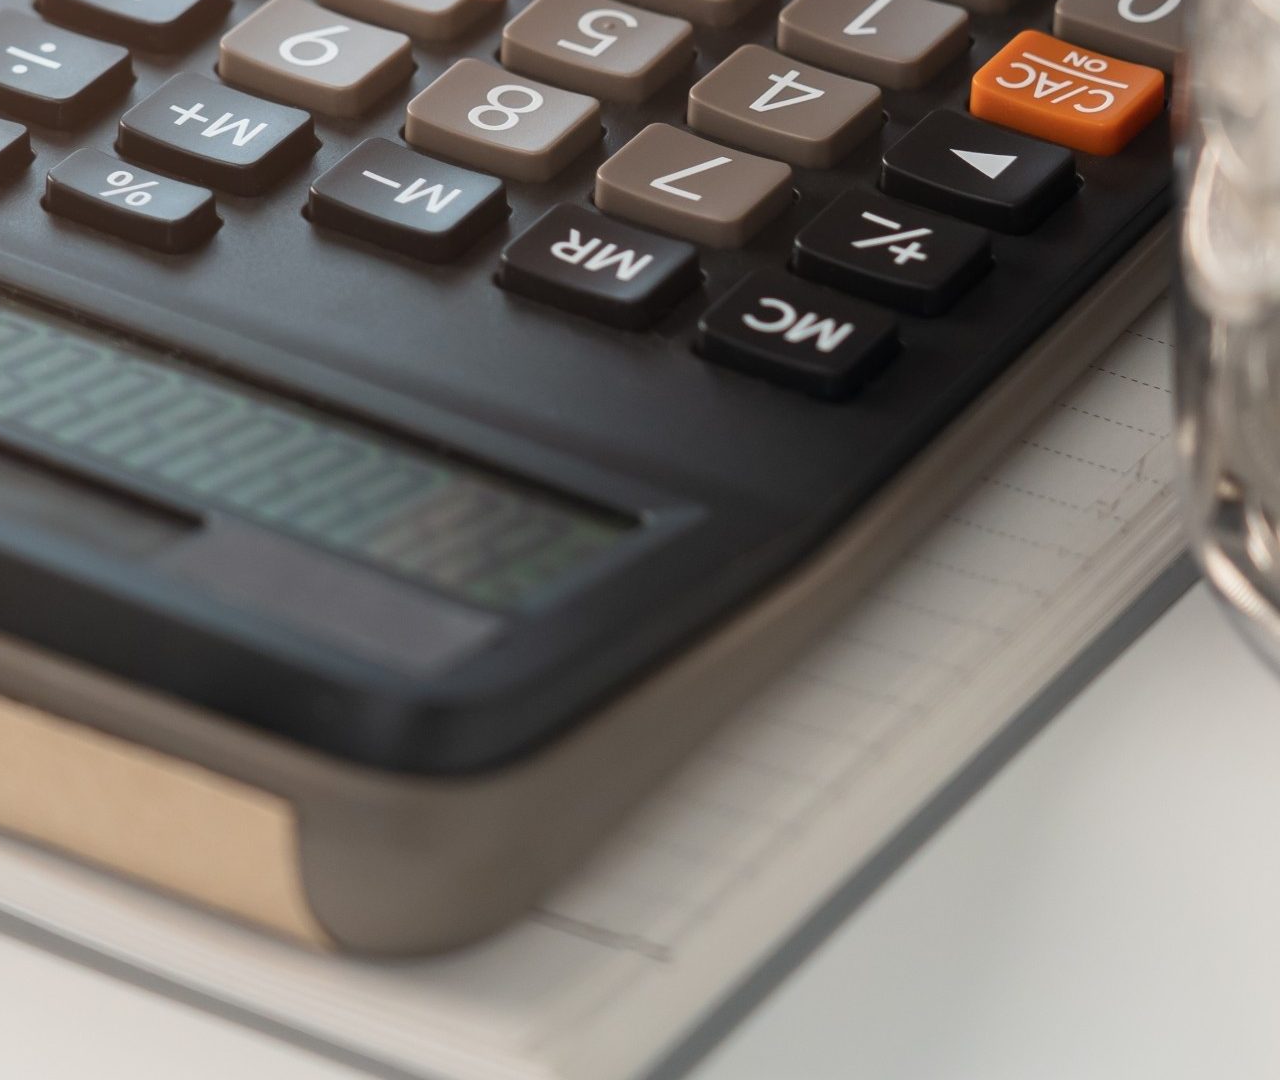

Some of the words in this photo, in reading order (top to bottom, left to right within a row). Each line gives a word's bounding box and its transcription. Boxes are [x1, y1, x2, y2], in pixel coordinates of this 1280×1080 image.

[279, 26, 350, 67] 9
[558, 10, 637, 57] 5
[1062, 51, 1109, 73] ON
[468, 85, 543, 130] 8
[749, 70, 824, 111] 4
[995, 60, 1116, 114] C/AC
[170, 103, 268, 146] M+
[100, 171, 159, 206] %
[650, 157, 732, 200] 7
[551, 229, 653, 281] MR
[742, 296, 854, 351] MC
